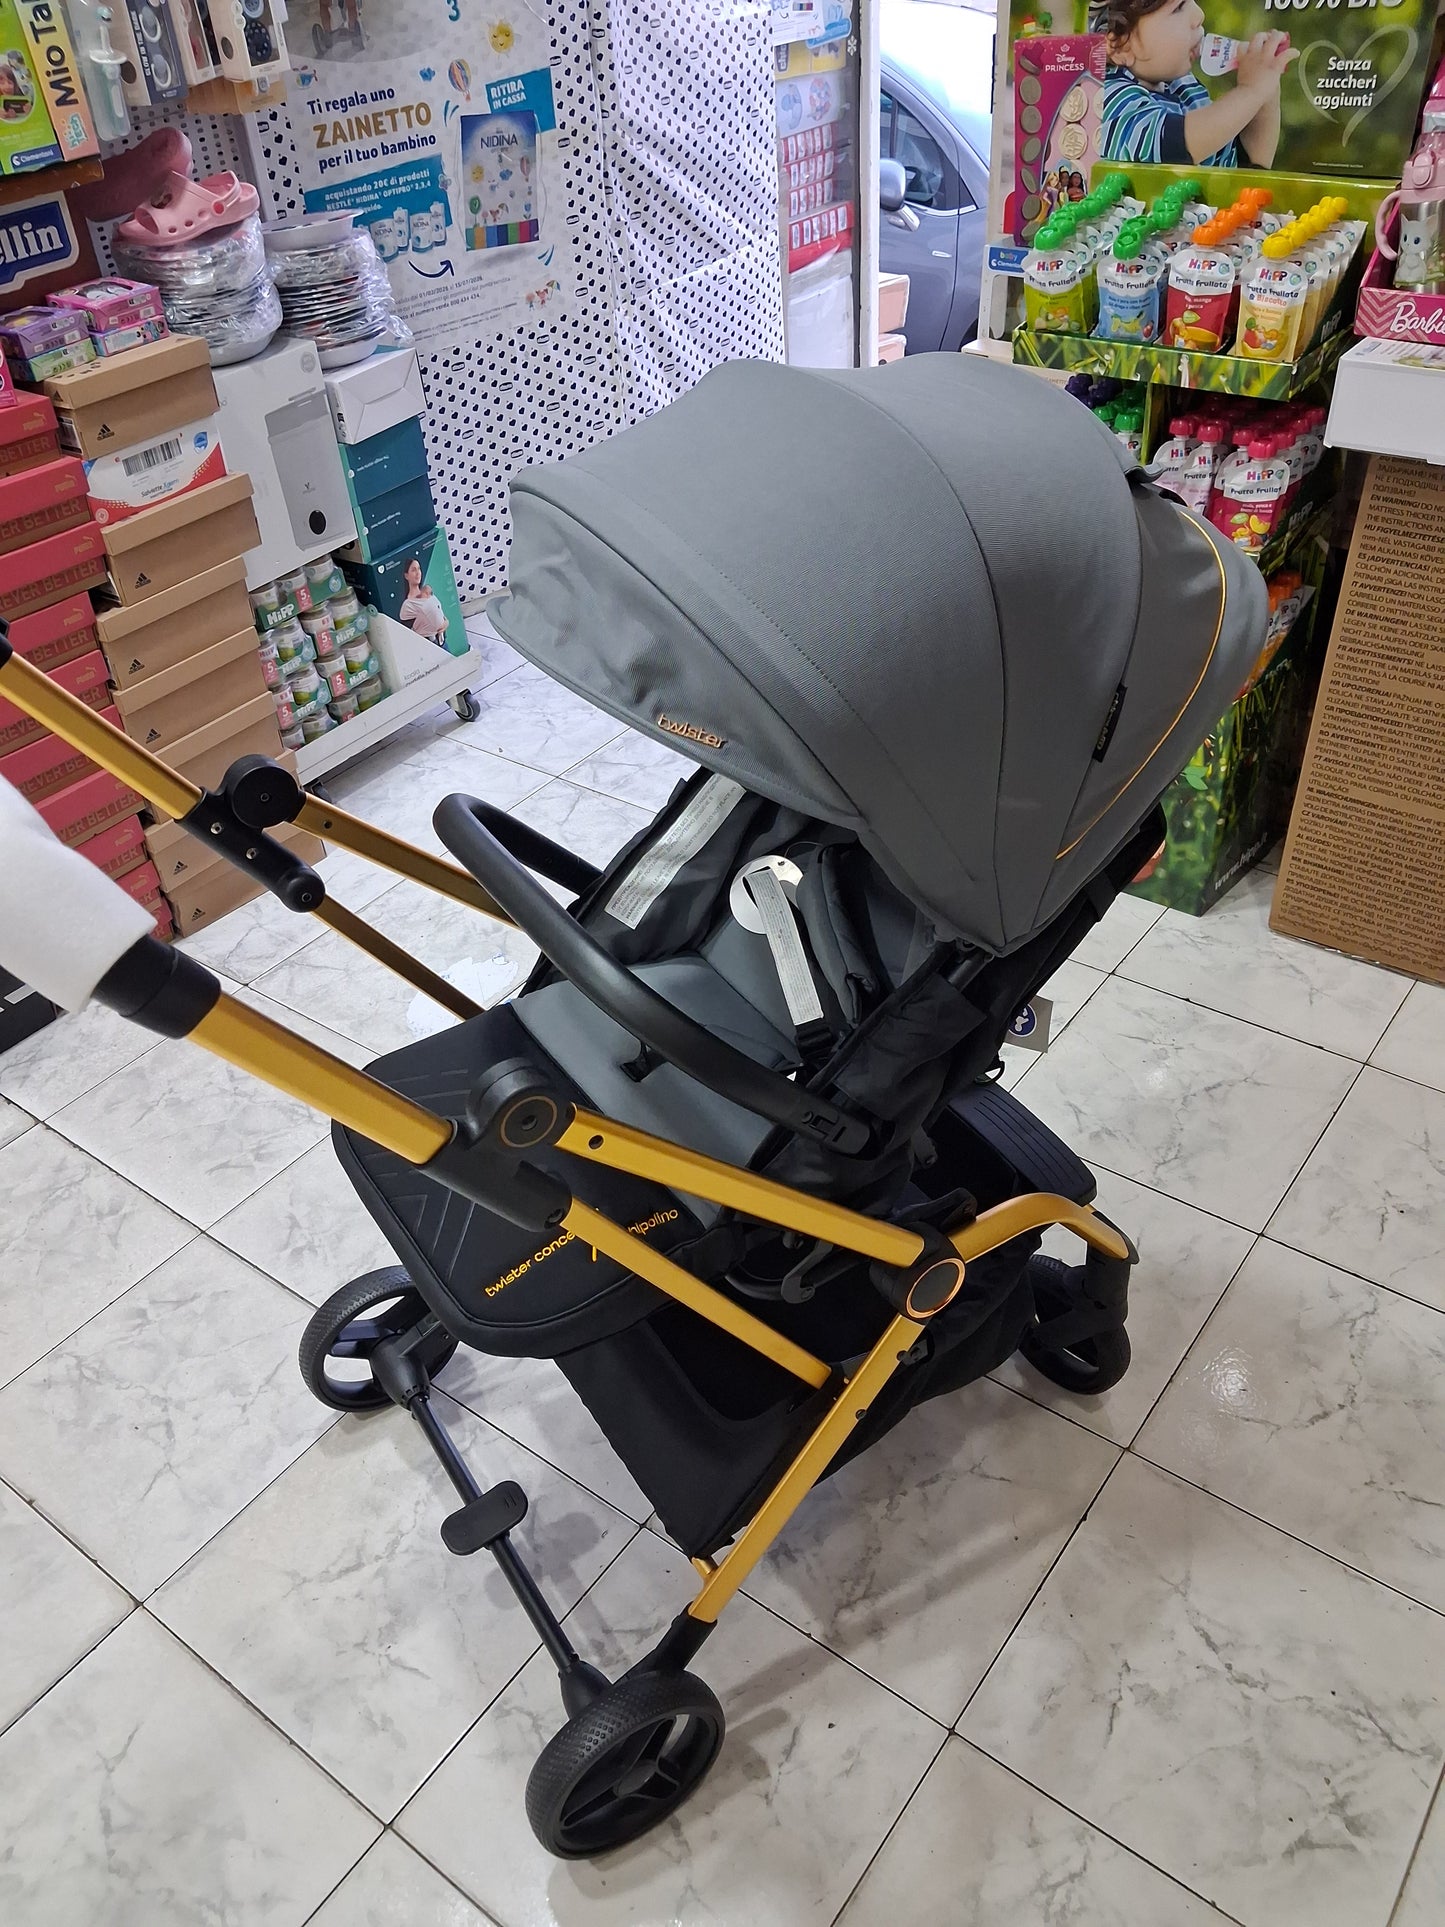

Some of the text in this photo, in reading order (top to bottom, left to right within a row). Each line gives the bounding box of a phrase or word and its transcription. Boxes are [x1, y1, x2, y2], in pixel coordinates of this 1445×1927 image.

[21, 0, 79, 107] Mio Ta
[1045, 62, 1085, 72] PRINCESS
[1327, 56, 1372, 72] Senza
[490, 79, 524, 98] RITIRA
[1316, 74, 1378, 90] zuccheri
[307, 87, 395, 115] Ti regala uno
[493, 93, 527, 109] IN CASSA
[313, 102, 432, 149] ZAINETTO
[480, 133, 518, 150] NIDINA
[318, 133, 436, 174] per il tuo bambino
[324, 168, 430, 202] acquistando 20€ di prodotti
[1036, 259, 1064, 272] HiPP
[1115, 262, 1143, 274] HiPP
[1188, 258, 1217, 271] HiPP
[1048, 275, 1077, 288] Frullata
[1175, 276, 1228, 289] Frutta Frullata
[1259, 268, 1288, 281] HiPP
[1104, 278, 1155, 290] Frutta Frullata
[1256, 294, 1287, 307] Biscotto
[1269, 288, 1299, 299] Frullata
[1389, 301, 1445, 334] Barbie
[0, 436, 49, 463] BETTER
[1184, 472, 1207, 480] Frutta
[1246, 470, 1274, 481] HiPP
[1230, 486, 1282, 495] Frutta Frullat
[1381, 495, 1433, 510] WARNING! DO
[23, 499, 81, 527] BETTER
[1368, 503, 1436, 521] MATTRESS THICKER
[1363, 523, 1375, 531] HU
[1365, 513, 1433, 531] THE INSTRUCTIONS
[1359, 542, 1376, 551] NEM
[1392, 539, 1435, 552] VASTAGABB
[44, 560, 99, 590] BETTER
[1355, 561, 1434, 582] COLCHÓN ADICIONAL
[1358, 582, 1424, 600] AVVERTENZE! NON
[1403, 581, 1417, 589] LAS
[1349, 590, 1384, 602] CARRELLO
[1397, 599, 1440, 613] MATERASSO
[266, 603, 295, 626] HiPP
[1356, 610, 1437, 632] WARNUNGEN! LASSEN
[1343, 617, 1365, 627] LEGEN
[1379, 624, 1398, 634] KEINE
[335, 626, 356, 644] HiPP
[1341, 626, 1429, 650] NICHT ZUM LAUFEN ODER
[33, 629, 89, 663] BETTER
[1346, 646, 1413, 665] AVERTISSEMENTS!
[1333, 661, 1367, 674] CONVIENT
[1368, 669, 1381, 677] PAS
[1397, 675, 1426, 687] COURSE
[1346, 655, 1431, 679] PAS METTRE MATELAS
[349, 669, 368, 685] HiPP
[657, 712, 728, 749] twister
[66, 754, 92, 772] BET
[88, 792, 137, 821] BETTER
[627, 1207, 679, 1236] hipolino
[484, 1230, 576, 1298] twister conce
